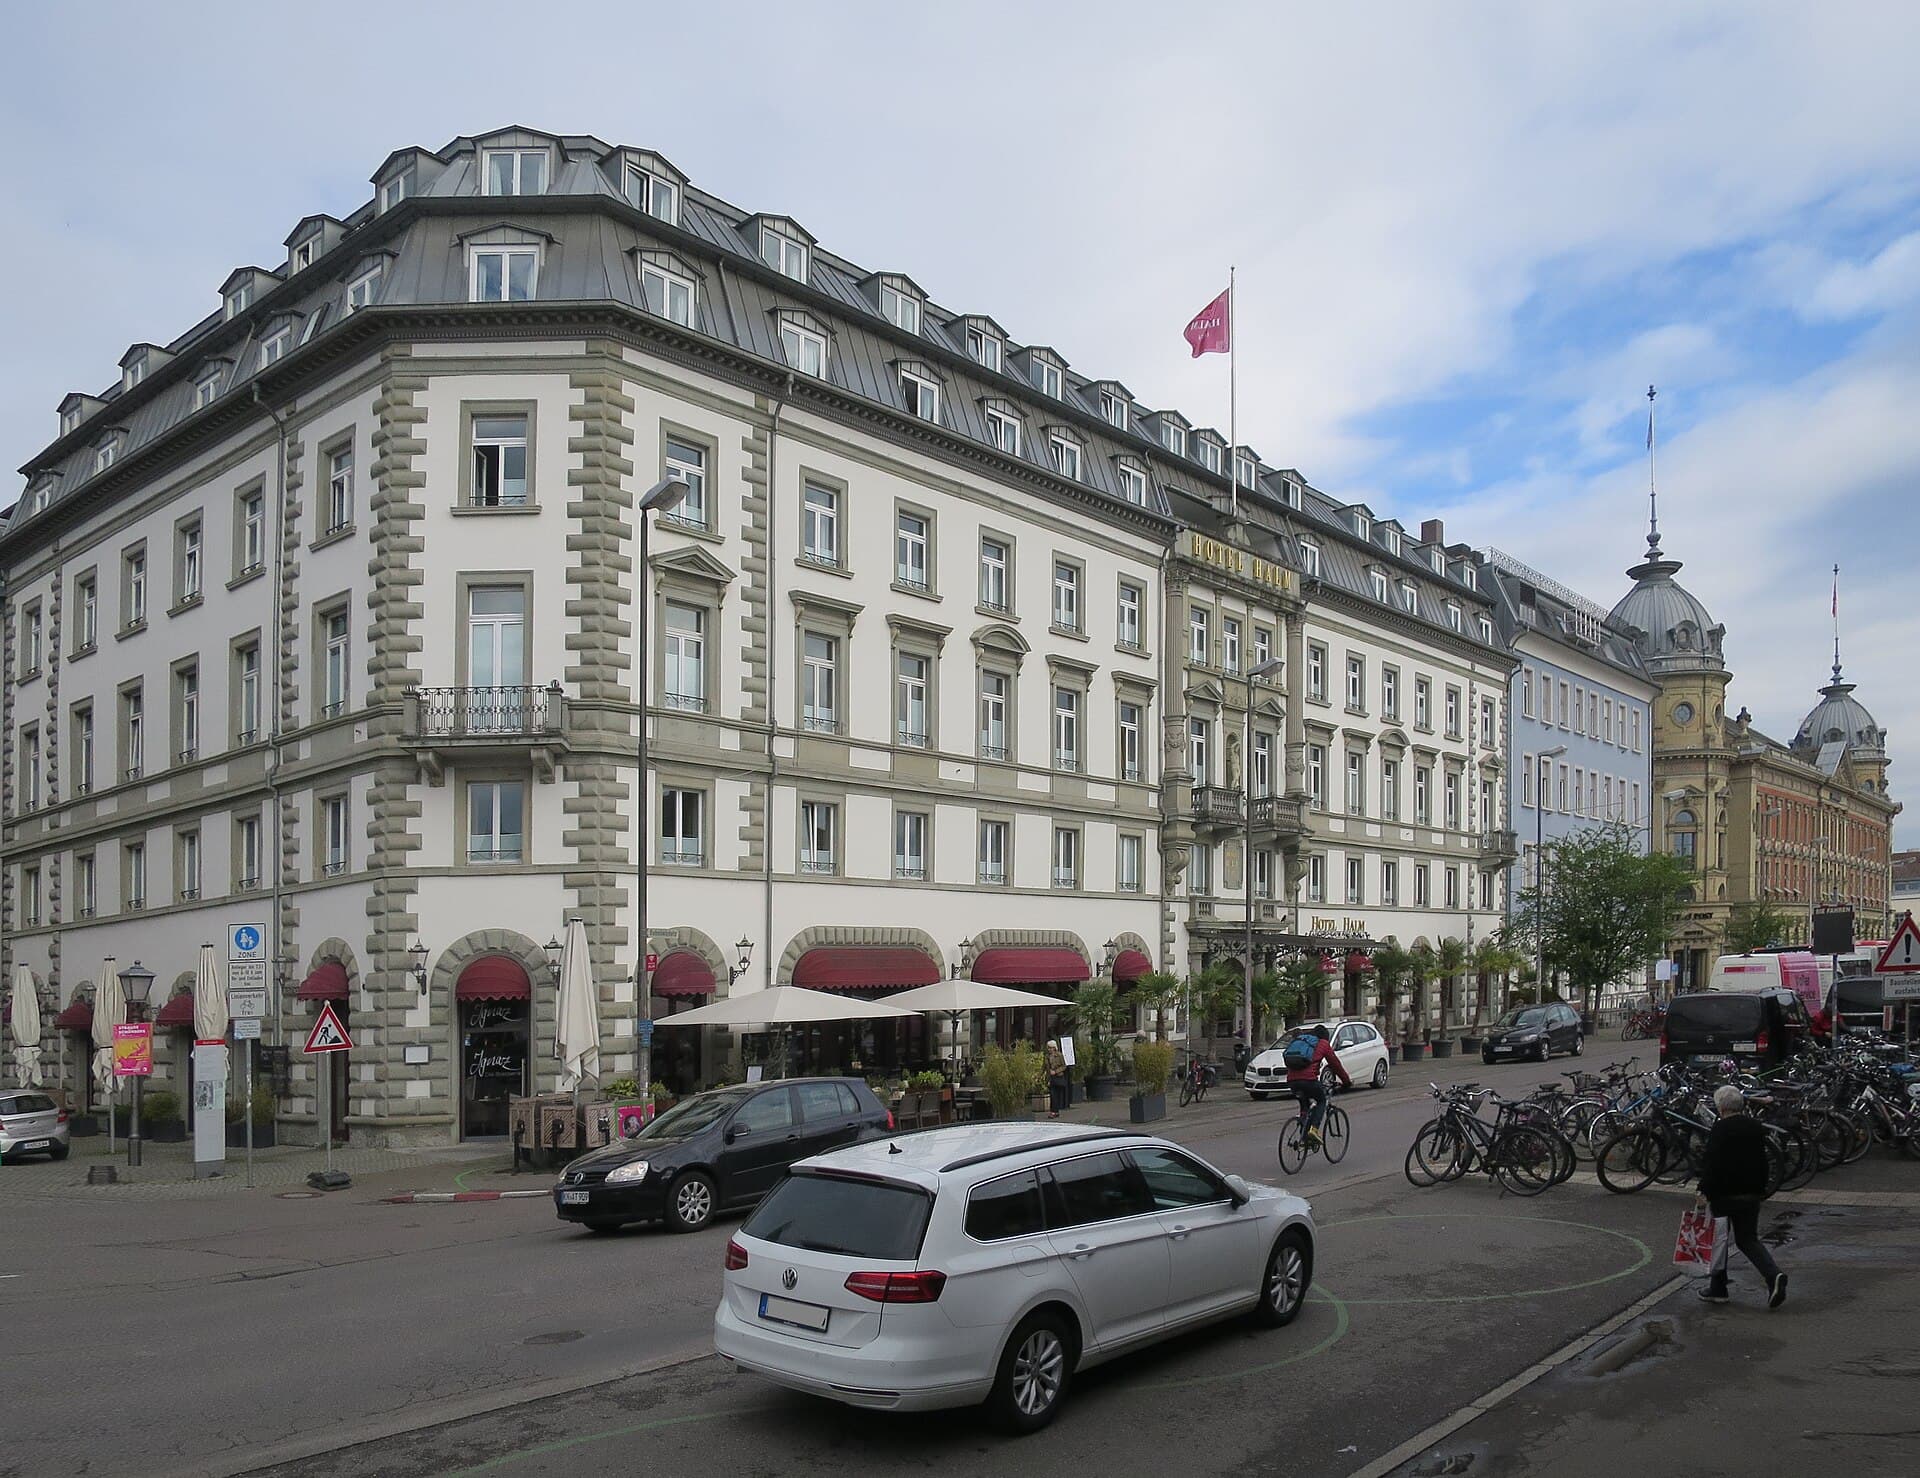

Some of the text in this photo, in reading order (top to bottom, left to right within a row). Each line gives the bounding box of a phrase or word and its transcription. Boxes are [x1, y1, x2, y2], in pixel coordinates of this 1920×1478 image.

[1192, 534, 1291, 590] HOTEL HALM
[1311, 916, 1365, 931] HOTEL HALM
